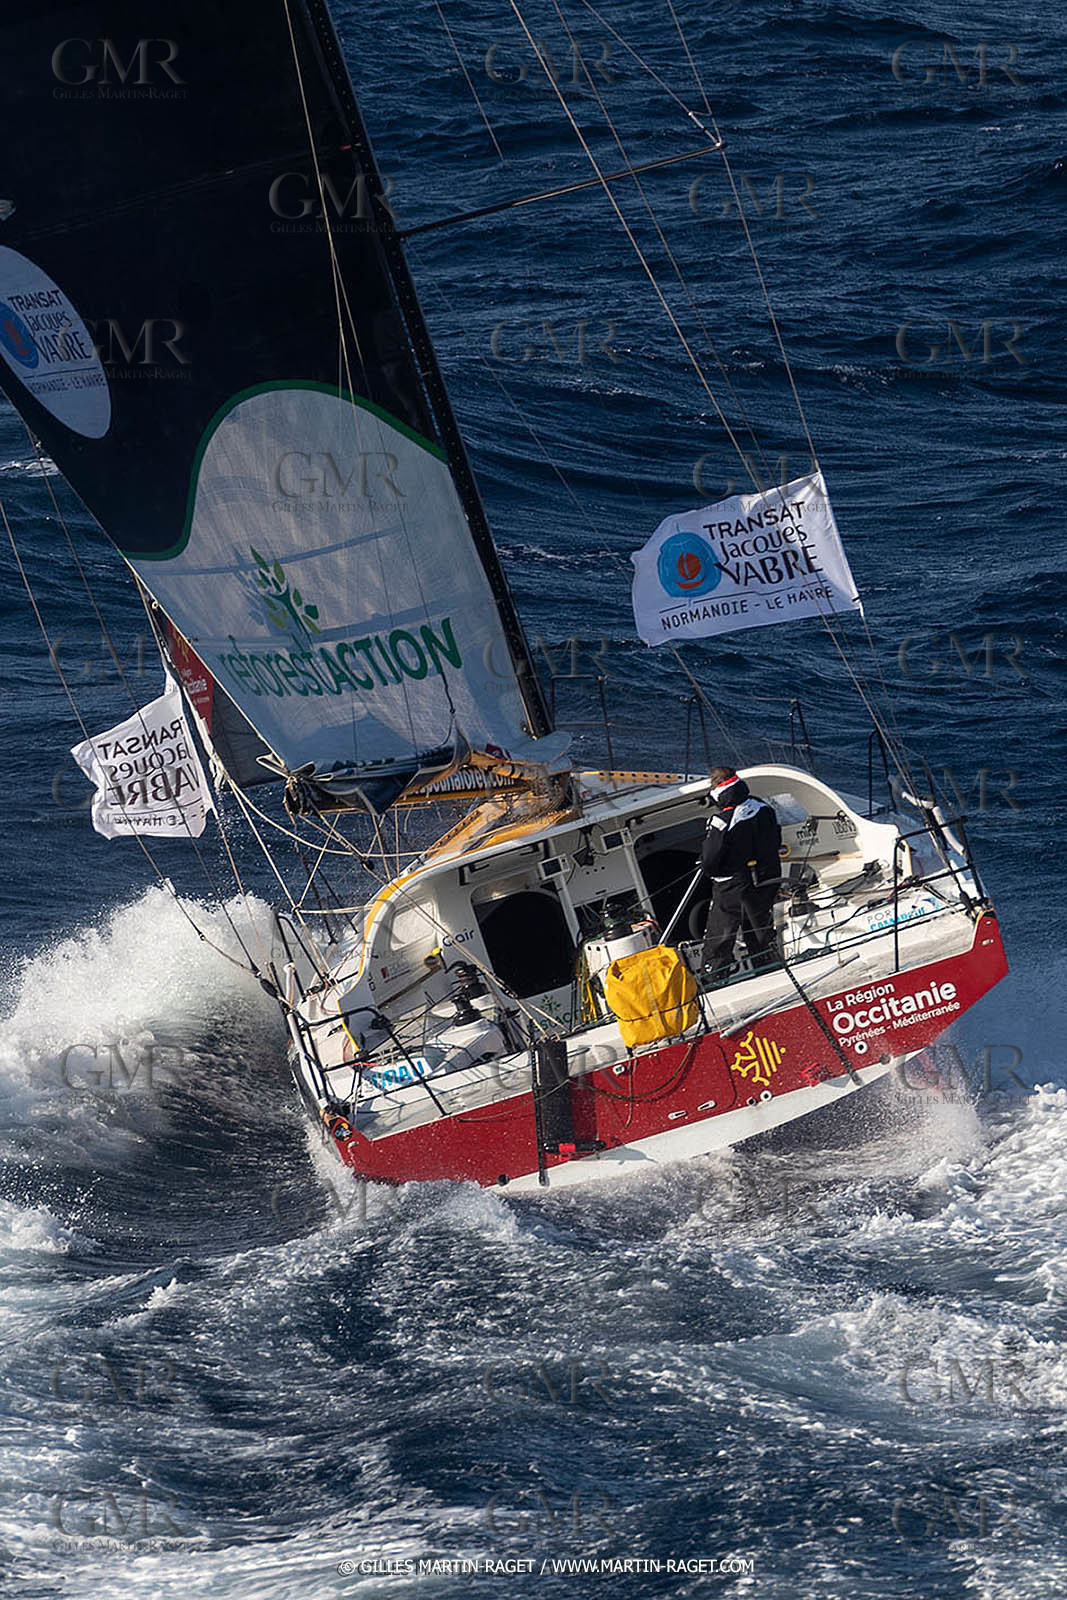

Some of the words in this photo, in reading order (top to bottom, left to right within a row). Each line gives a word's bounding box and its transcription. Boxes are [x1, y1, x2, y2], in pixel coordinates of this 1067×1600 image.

[8, 290, 62, 312] TRANSAT
[703, 501, 805, 541] TRANSAT
[715, 544, 823, 586] VABRE
[720, 524, 807, 565] Jacques
[661, 600, 748, 630] NORMANDIE
[768, 597, 784, 610] LE
[789, 586, 834, 604] HAVRE
[826, 1000, 844, 1013] La
[845, 983, 895, 1006] Région
[832, 981, 957, 1034] Occitanie
[838, 1026, 886, 1047] Pyrénées
[892, 1001, 960, 1030] Méditerranée
